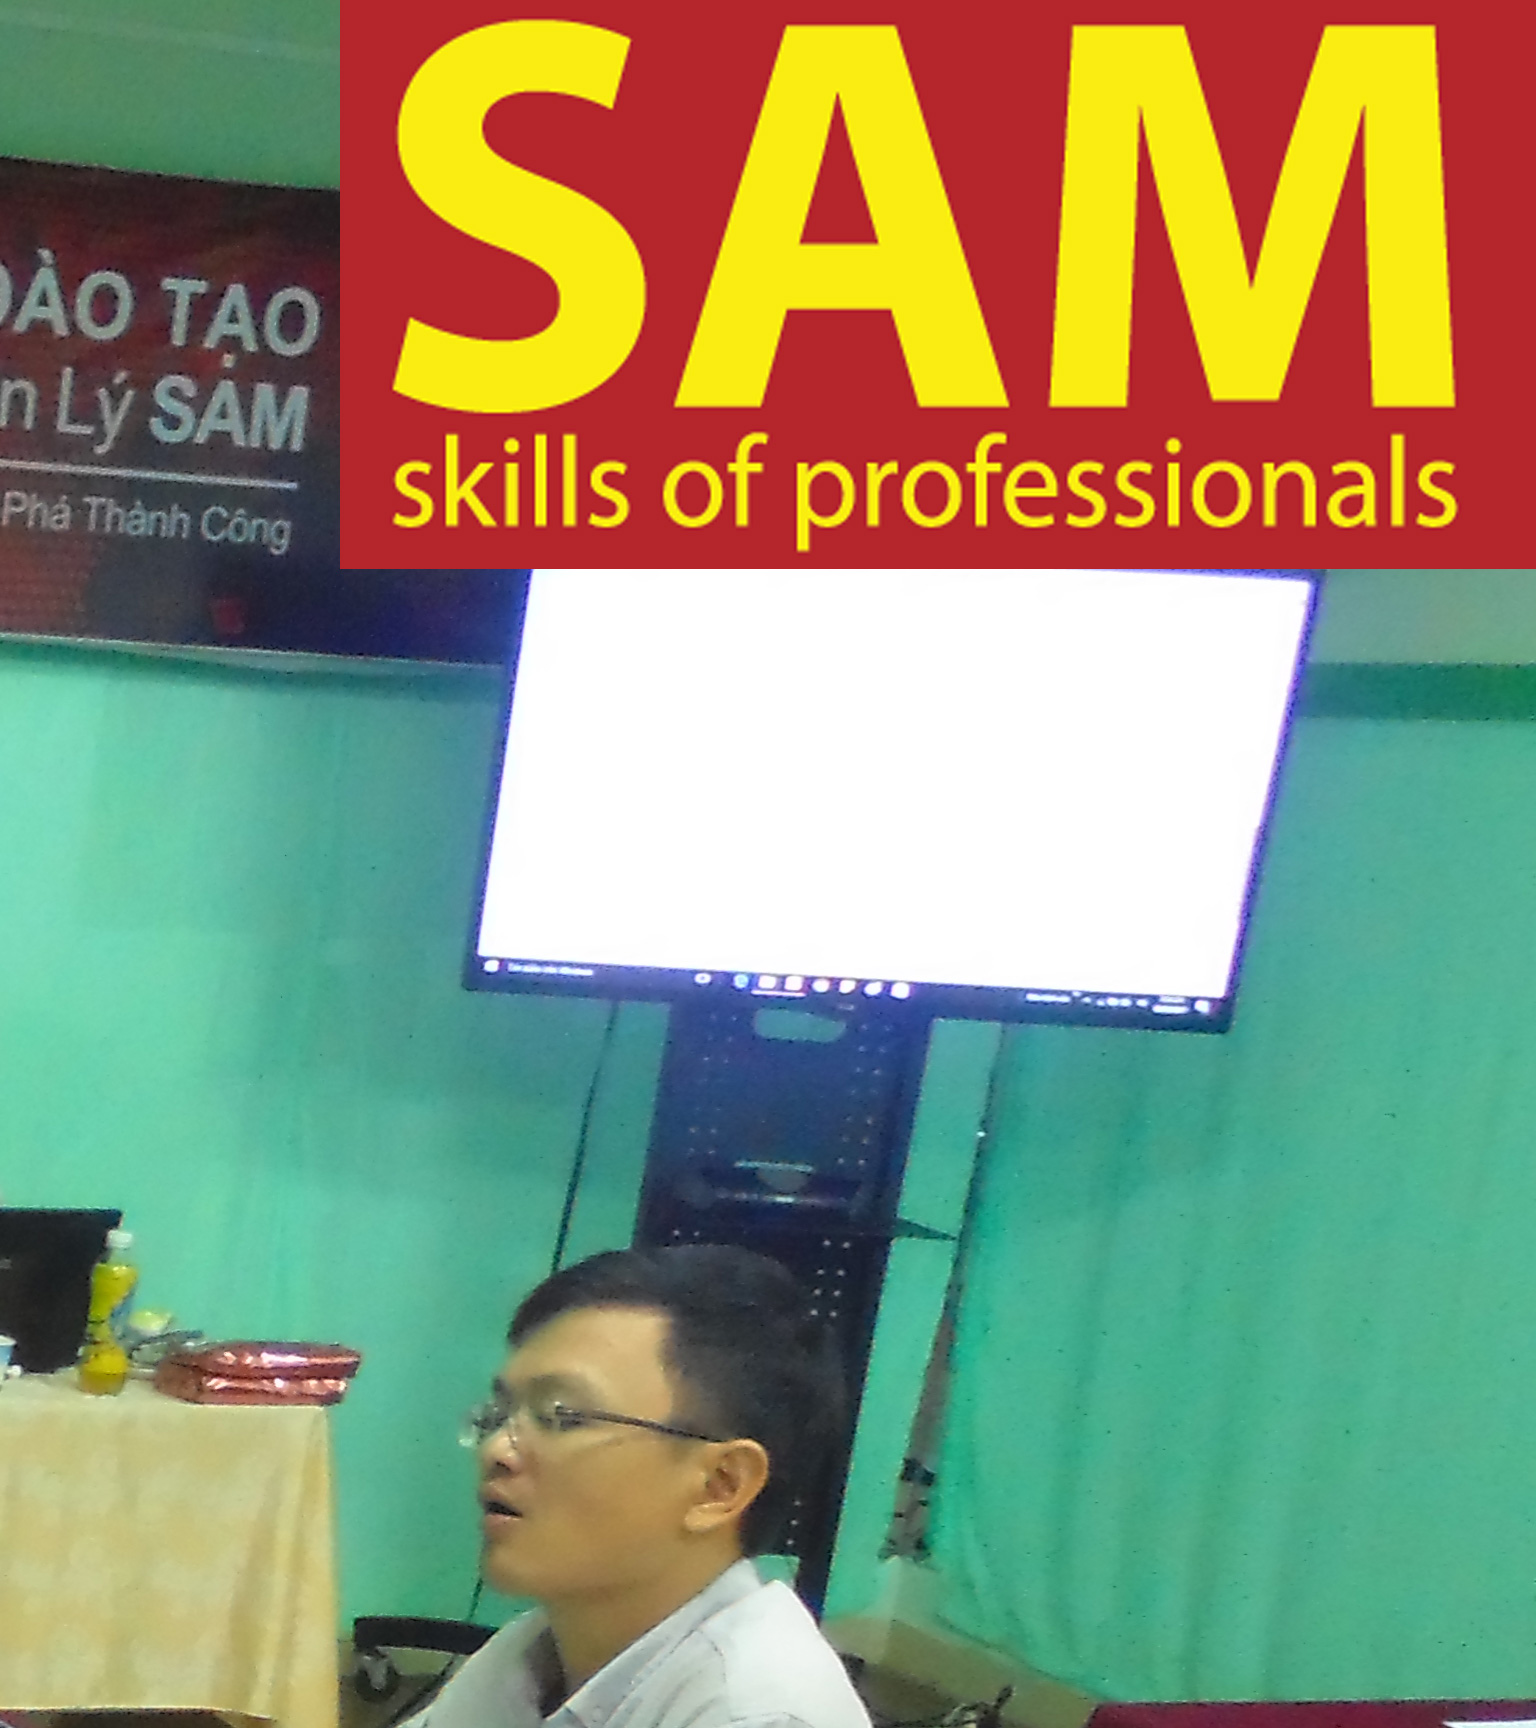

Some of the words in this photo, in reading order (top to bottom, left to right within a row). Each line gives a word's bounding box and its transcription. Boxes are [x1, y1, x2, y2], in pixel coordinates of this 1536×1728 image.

[160, 276, 322, 368] TẠO
[56, 366, 136, 455] Lý
[149, 373, 311, 453] SAM
[2, 491, 73, 532] Phá
[83, 495, 192, 540] Thành
[199, 503, 294, 556] Công
